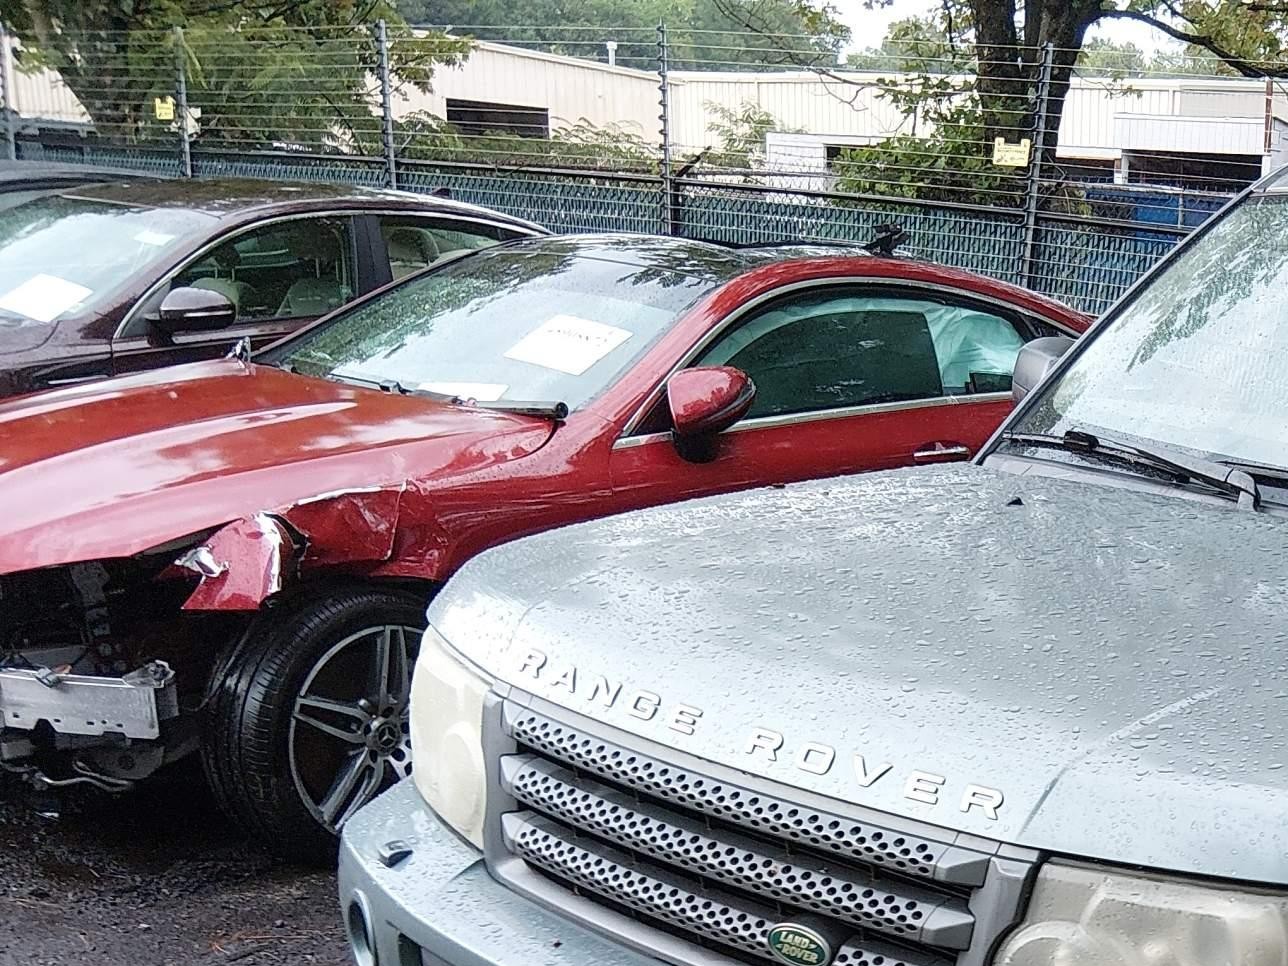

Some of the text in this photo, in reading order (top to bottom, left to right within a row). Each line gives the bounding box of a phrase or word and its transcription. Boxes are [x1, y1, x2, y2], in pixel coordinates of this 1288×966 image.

[517, 645, 1005, 820] RANGE ROVER
[780, 931, 811, 949] LAND
[781, 943, 819, 963] ROVER
